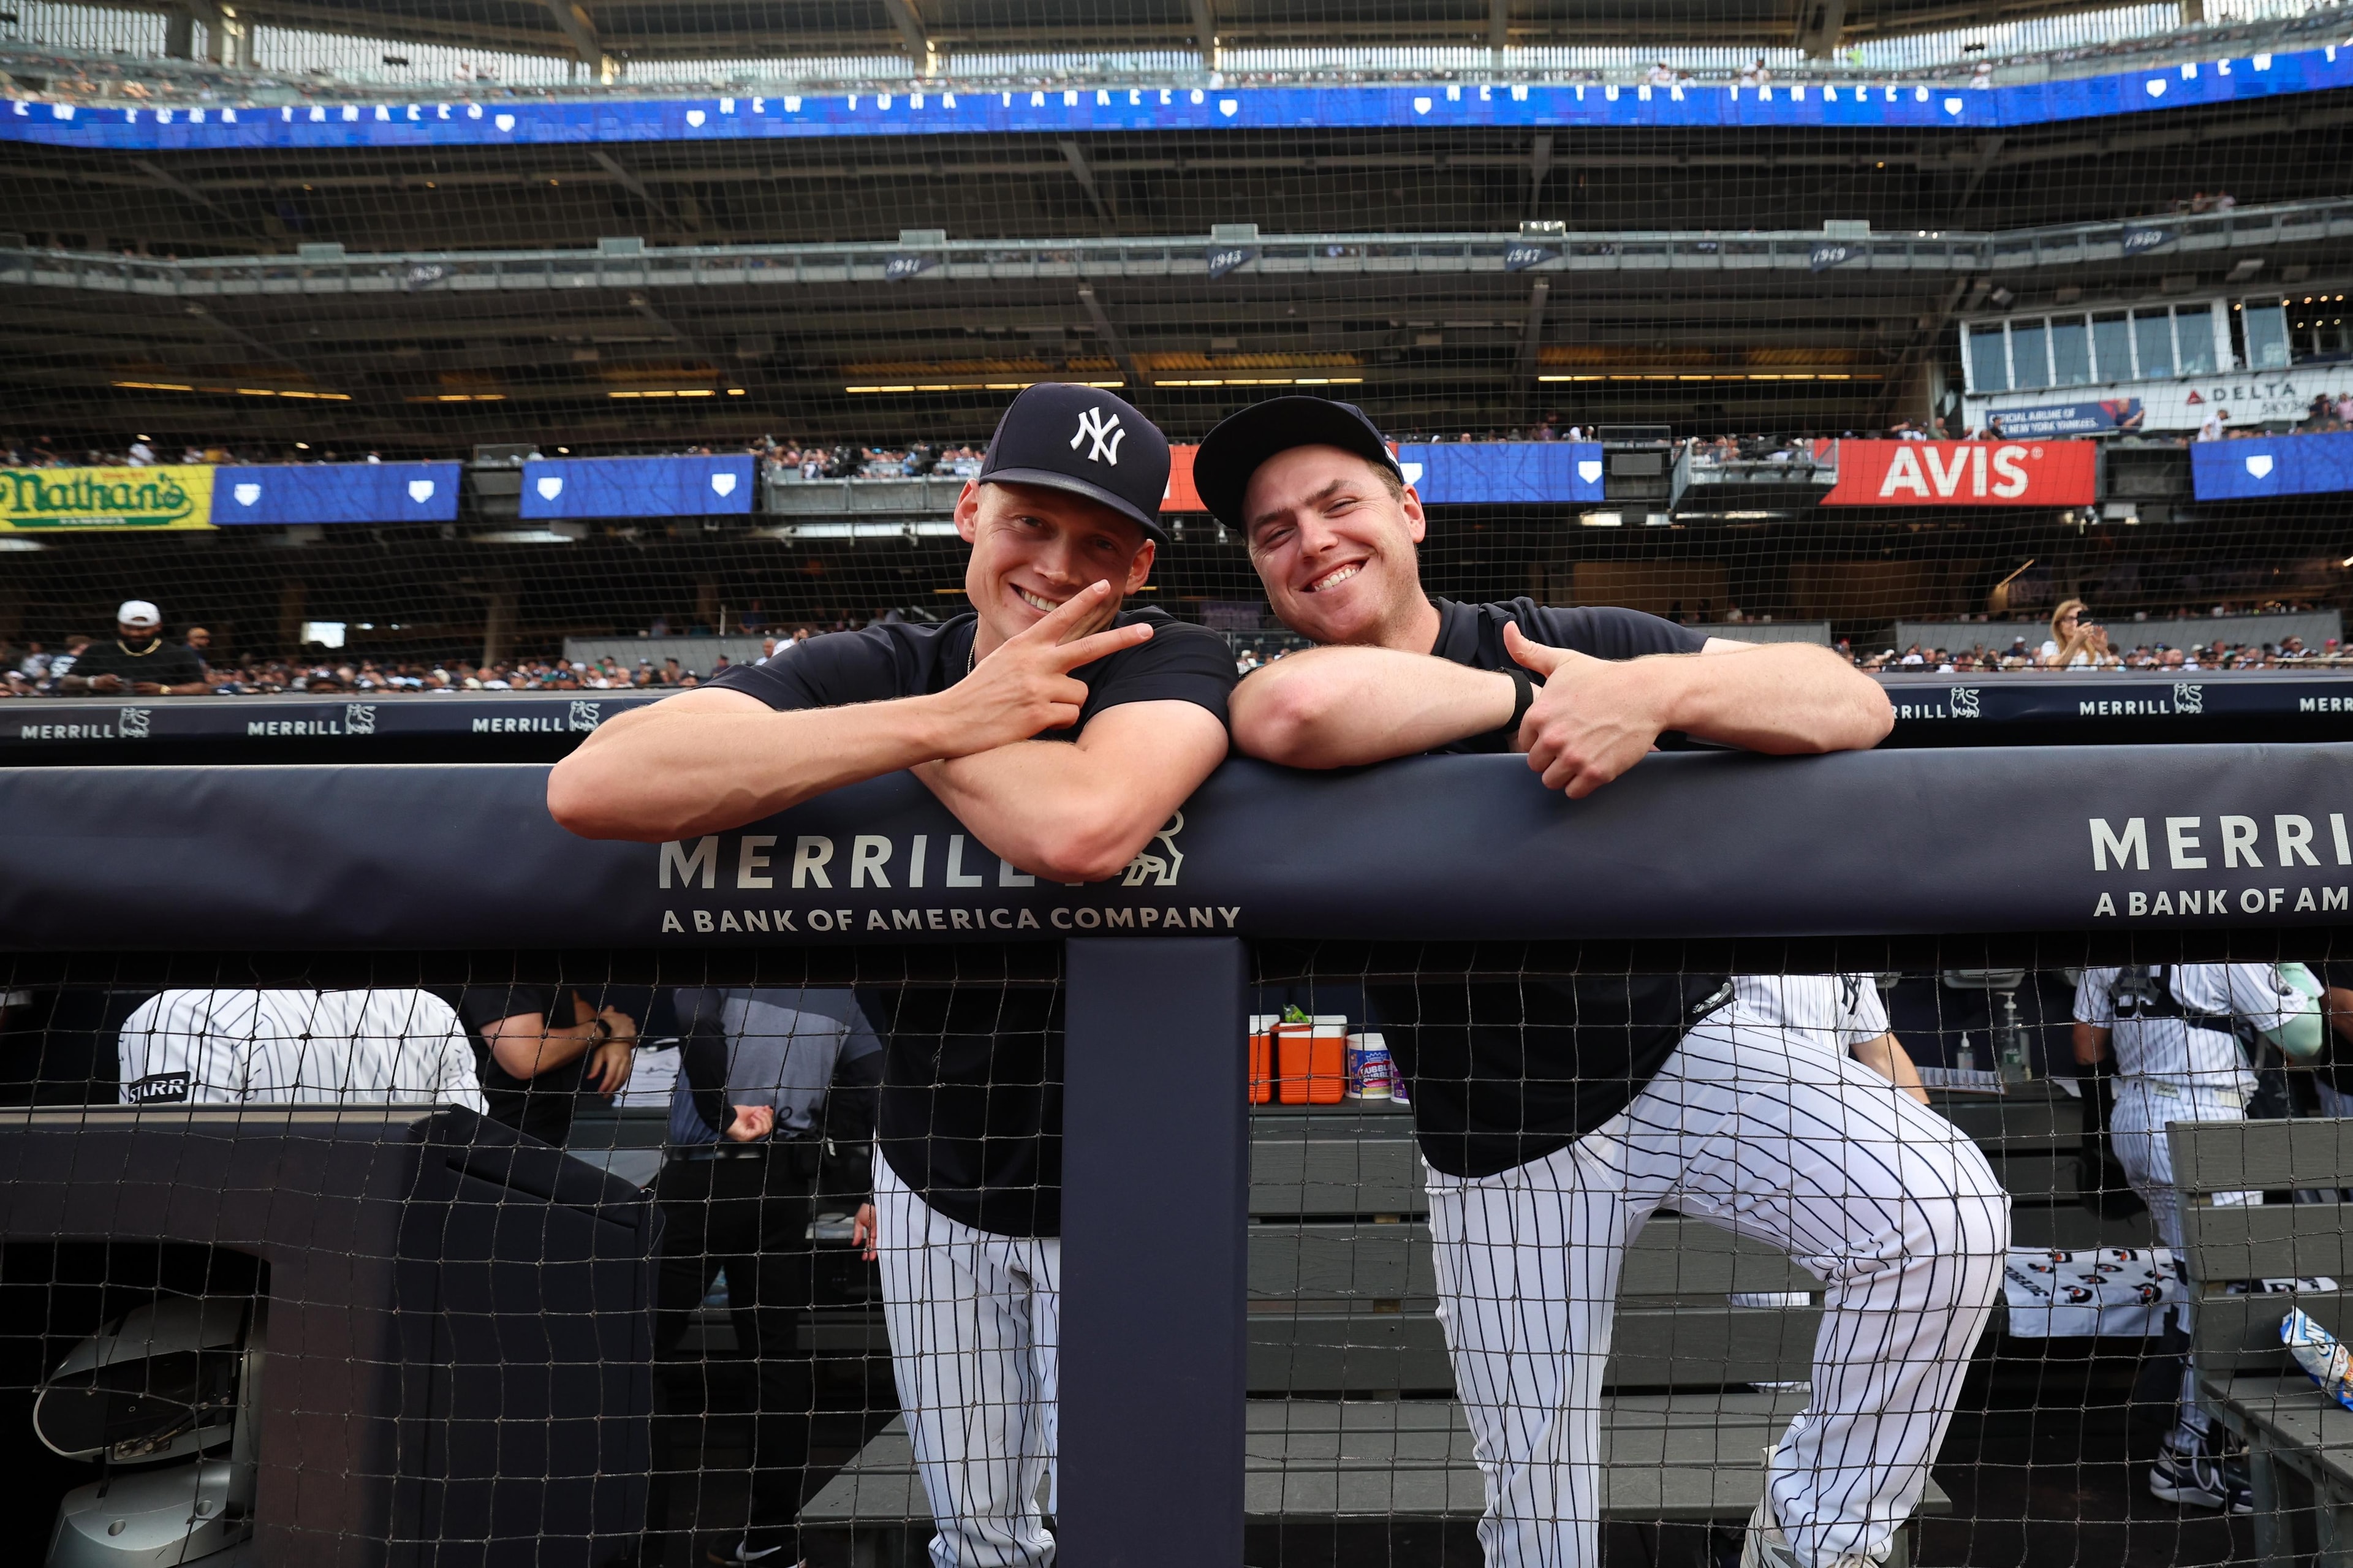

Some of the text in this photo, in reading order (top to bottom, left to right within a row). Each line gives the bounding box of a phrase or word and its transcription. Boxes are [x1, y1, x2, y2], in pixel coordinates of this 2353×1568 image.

[2212, 382, 2297, 401] DELTA
[1070, 407, 1126, 467] NY
[1879, 445, 2029, 498] AVIS
[1892, 705, 1947, 719] RRILL
[2079, 700, 2170, 716] MERRILL
[21, 724, 114, 739] MERRILL
[247, 720, 341, 735] MERRILL
[472, 717, 564, 732] MERRILL
[2088, 812, 2352, 871] MERRI
[2093, 892, 2117, 917] A
[2128, 890, 2229, 917] BANK
[2240, 888, 2285, 914] OF
[661, 906, 1241, 933] A BANK OF AMERICA COMPANY
[128, 1078, 186, 1104] STARR
